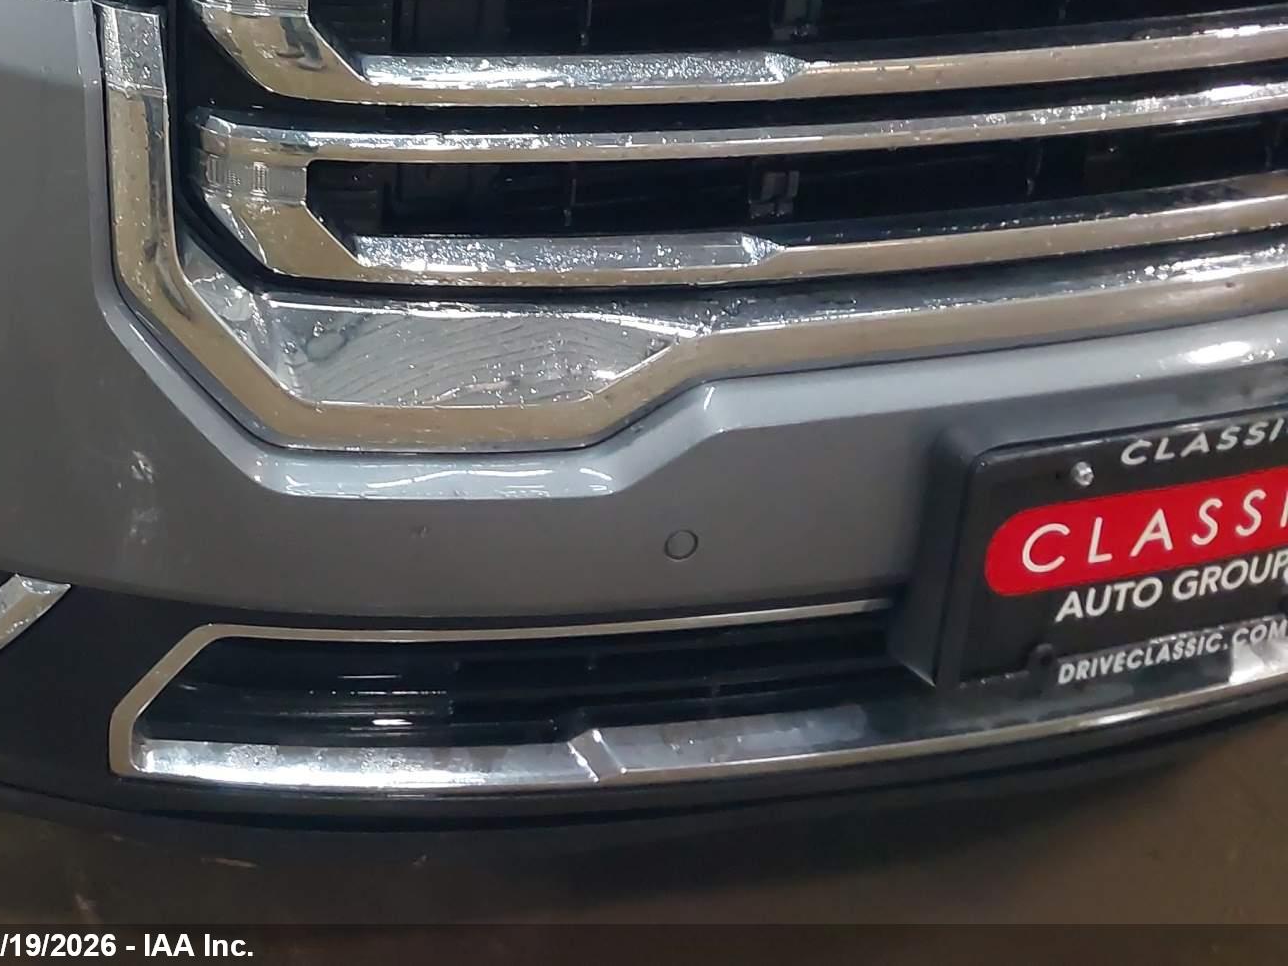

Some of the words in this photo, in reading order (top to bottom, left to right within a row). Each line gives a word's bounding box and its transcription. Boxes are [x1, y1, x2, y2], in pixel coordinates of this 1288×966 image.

[1055, 577, 1163, 623] AUTO
[1172, 549, 1288, 603] GROUP
[1057, 618, 1288, 685] DRIVECLASSIC.COM
